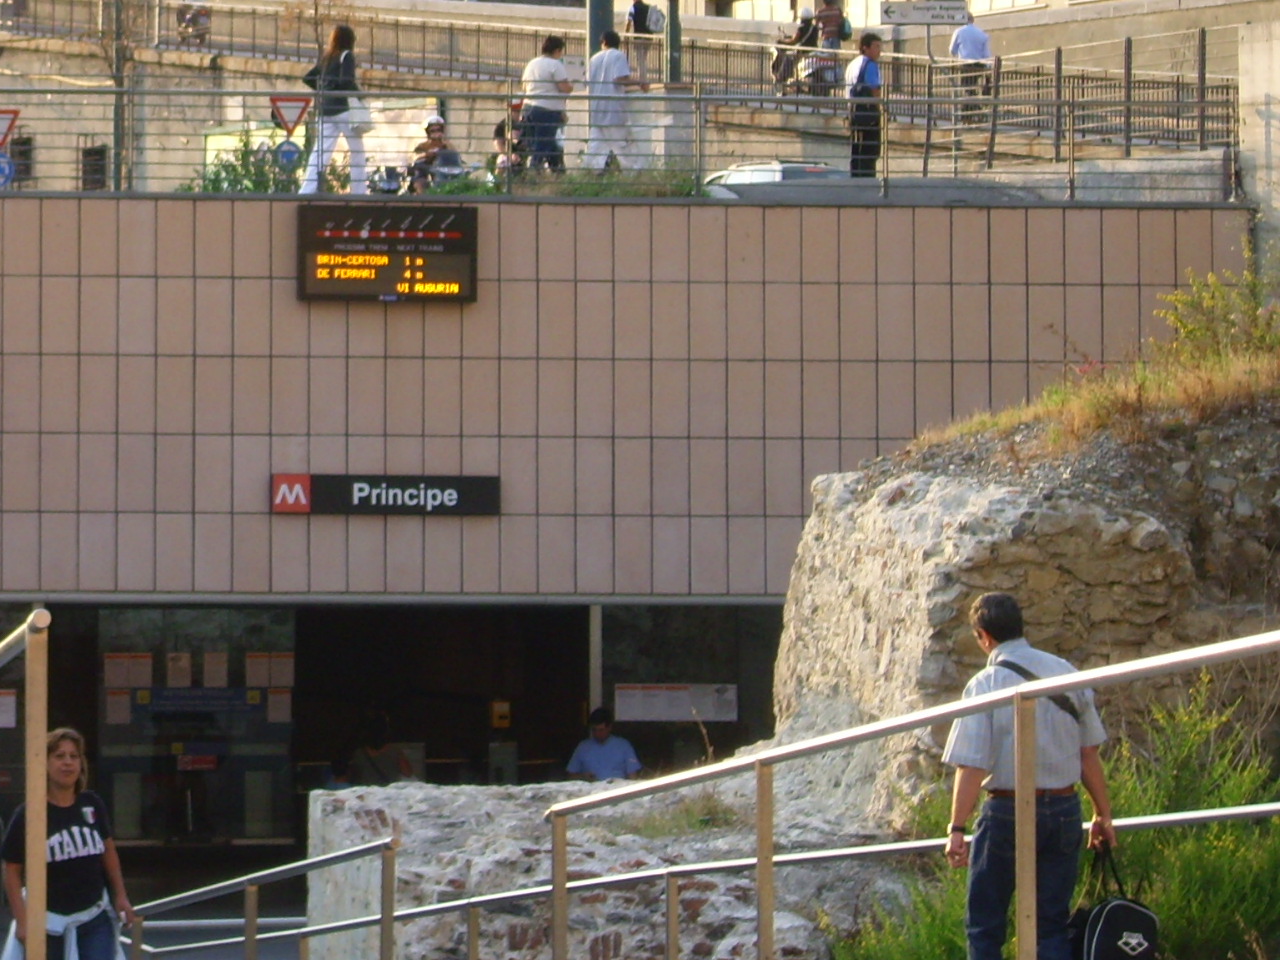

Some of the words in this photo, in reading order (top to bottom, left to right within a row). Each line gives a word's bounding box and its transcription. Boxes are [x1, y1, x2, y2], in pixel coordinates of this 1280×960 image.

[316, 268, 330, 279] DE
[334, 268, 376, 279] FERRARI
[403, 269, 411, 279] 4
[274, 483, 307, 505] M
[352, 482, 459, 512] Principe
